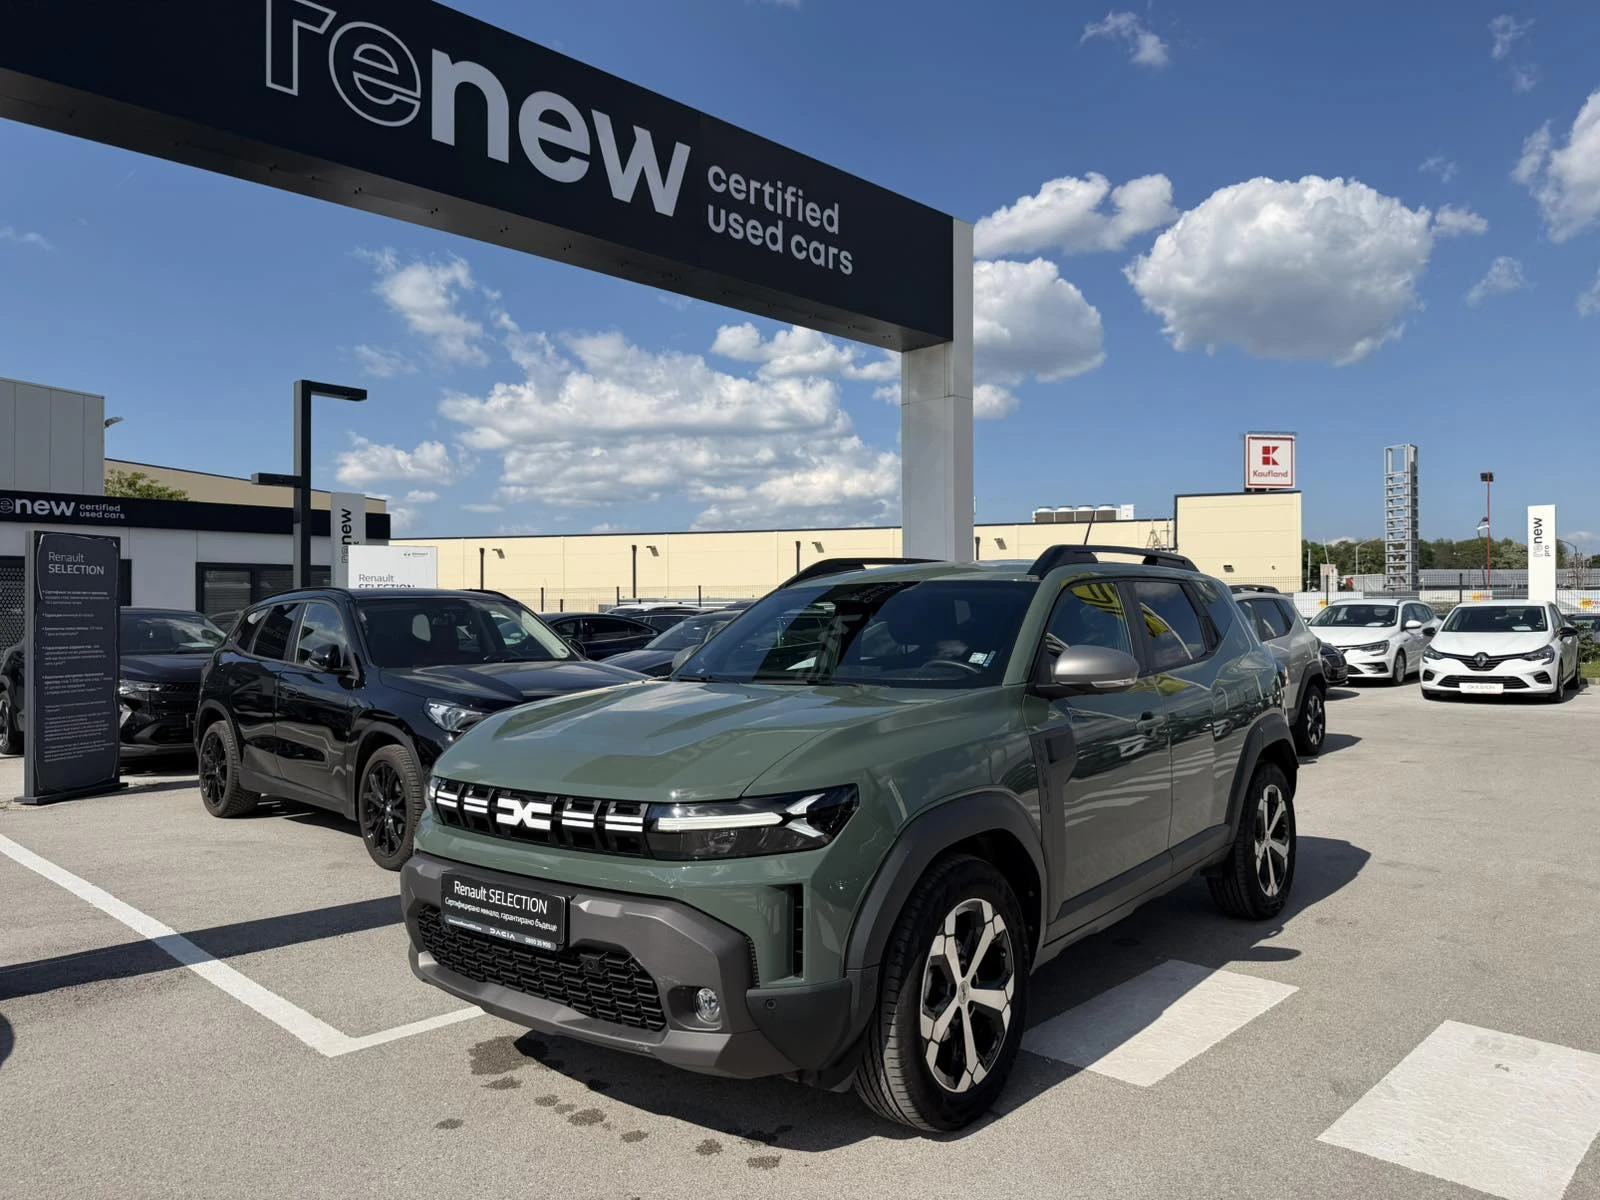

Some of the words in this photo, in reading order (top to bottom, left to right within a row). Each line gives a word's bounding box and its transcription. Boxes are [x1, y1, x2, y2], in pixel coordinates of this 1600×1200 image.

[265, 0, 692, 217] renew
[707, 164, 839, 235] certified
[707, 204, 784, 253] used
[790, 234, 853, 275] cars
[1252, 469, 1289, 478] Kaufland
[0, 497, 76, 517] enew
[79, 503, 121, 511] certified
[48, 551, 85, 562] Renault
[48, 564, 105, 575] SELECTION
[358, 573, 394, 583] Renault
[453, 880, 487, 901] Renault
[488, 888, 548, 915] SELECTION
[500, 911, 535, 927] гарантирано
[489, 927, 516, 940] DACIA
